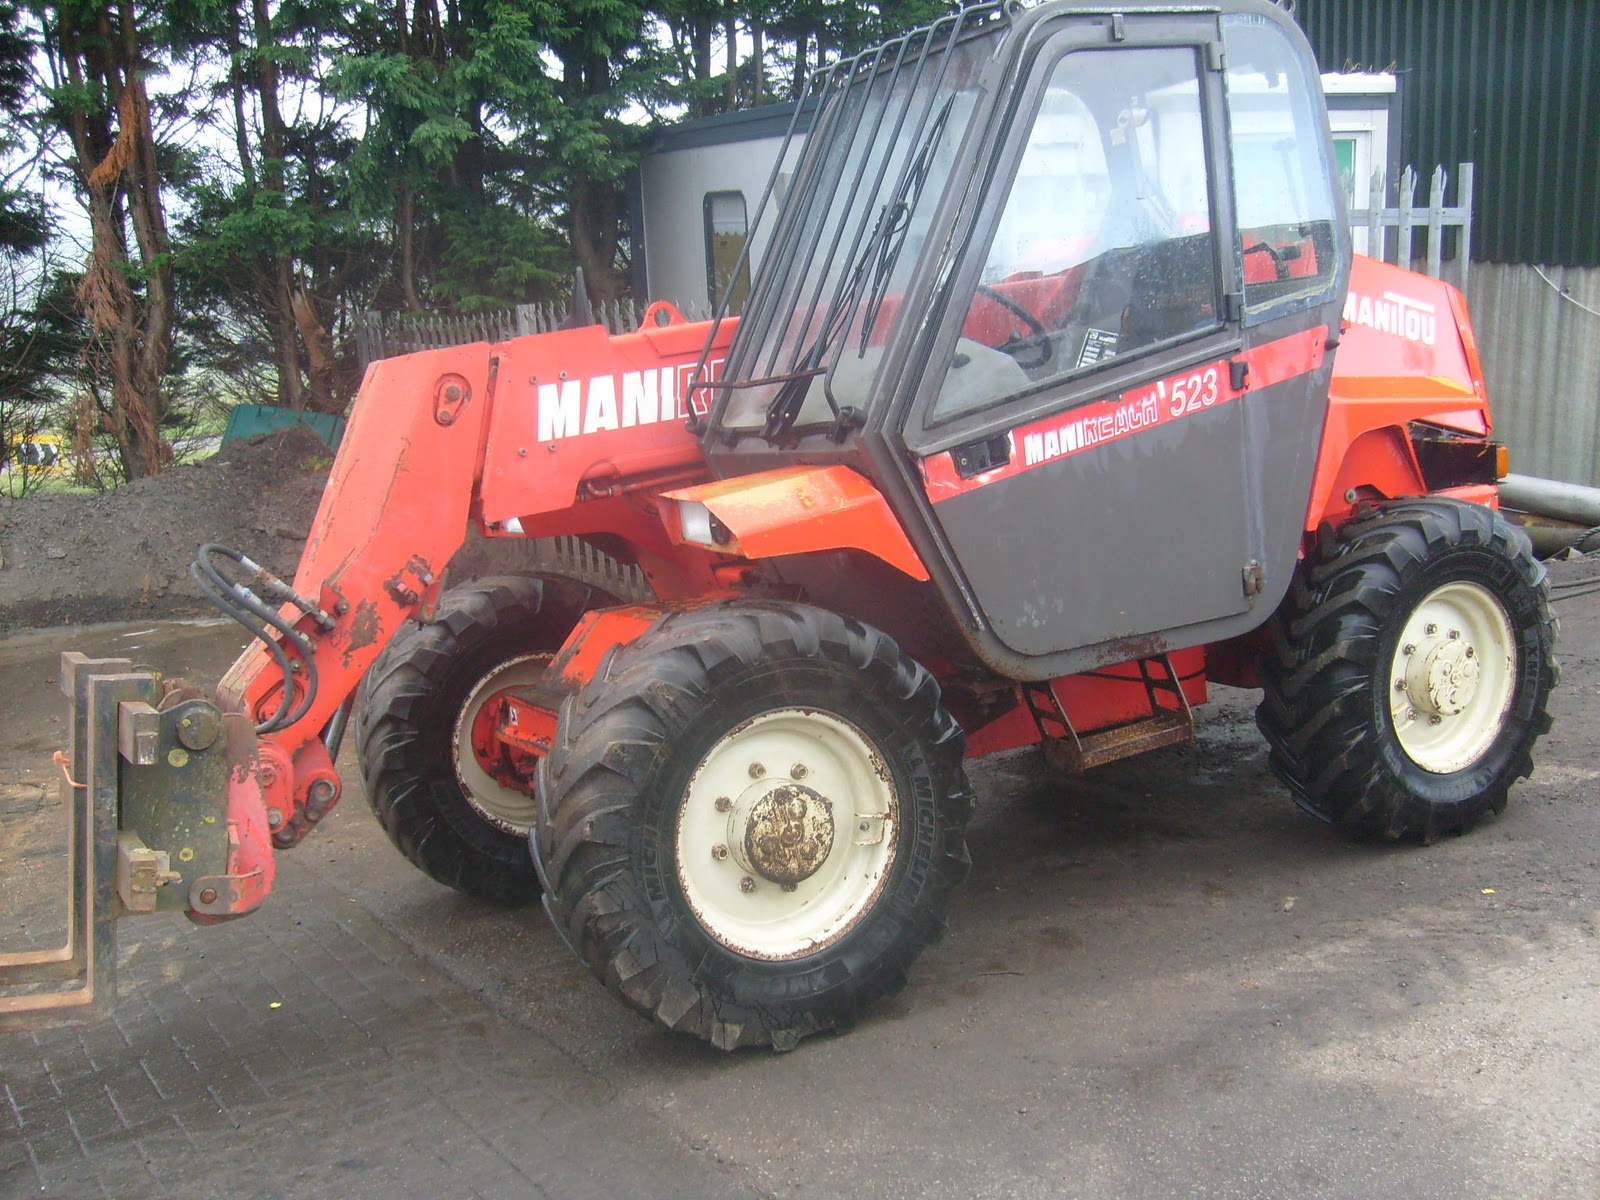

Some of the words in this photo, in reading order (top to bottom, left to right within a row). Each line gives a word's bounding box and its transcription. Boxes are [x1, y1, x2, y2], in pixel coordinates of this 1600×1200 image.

[1343, 291, 1435, 345] MANITOU
[1024, 393, 1158, 466] MANIREACH
[1170, 368, 1218, 417] 523
